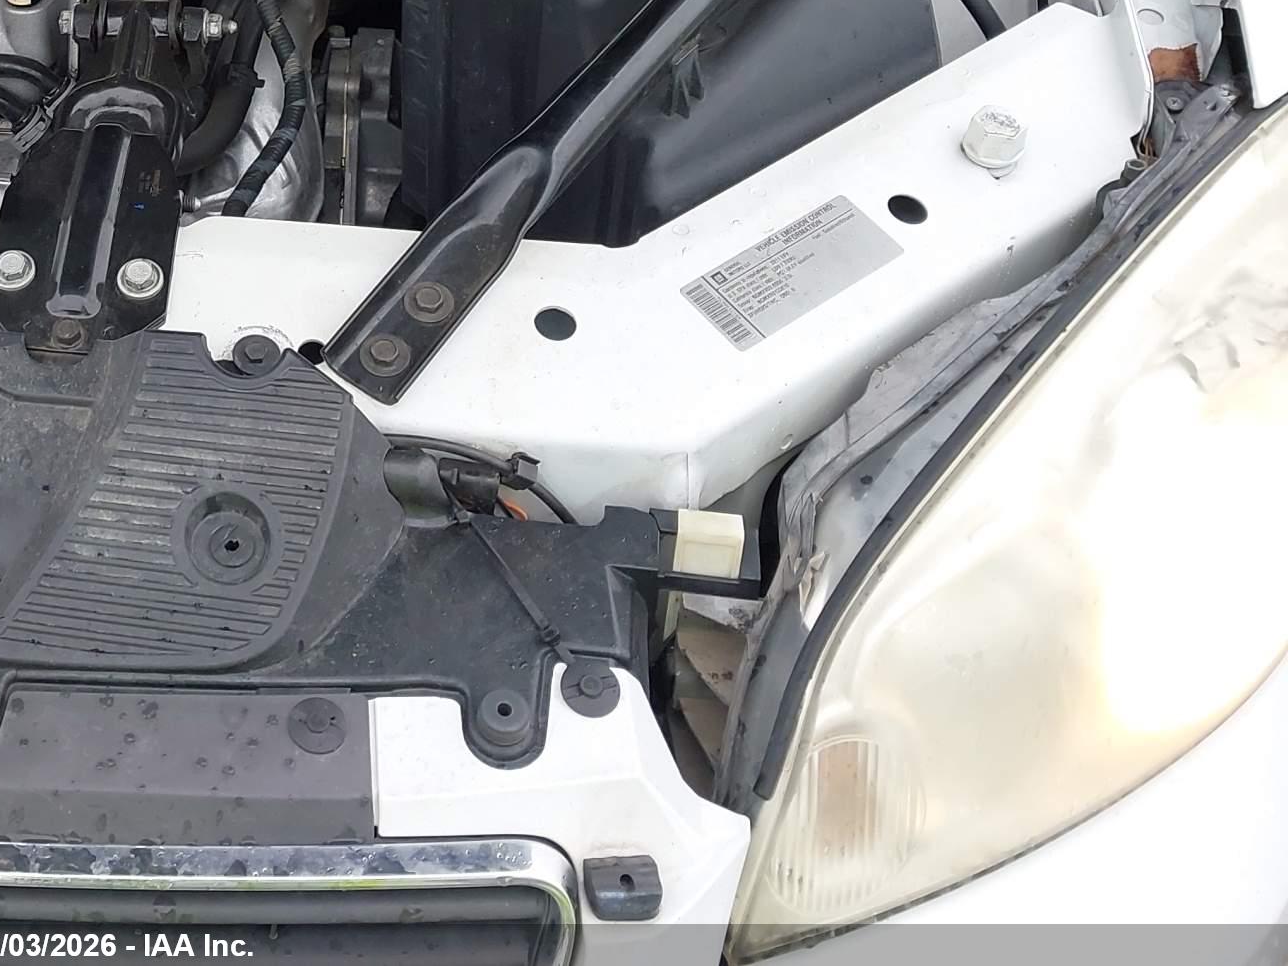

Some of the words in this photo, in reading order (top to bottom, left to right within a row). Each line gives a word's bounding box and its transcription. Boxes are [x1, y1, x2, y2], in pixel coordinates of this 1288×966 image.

[755, 234, 781, 252] VEHICLE
[780, 218, 809, 238] EMISSION
[808, 203, 837, 222] CONTROL
[782, 219, 823, 245] INFORMATION
